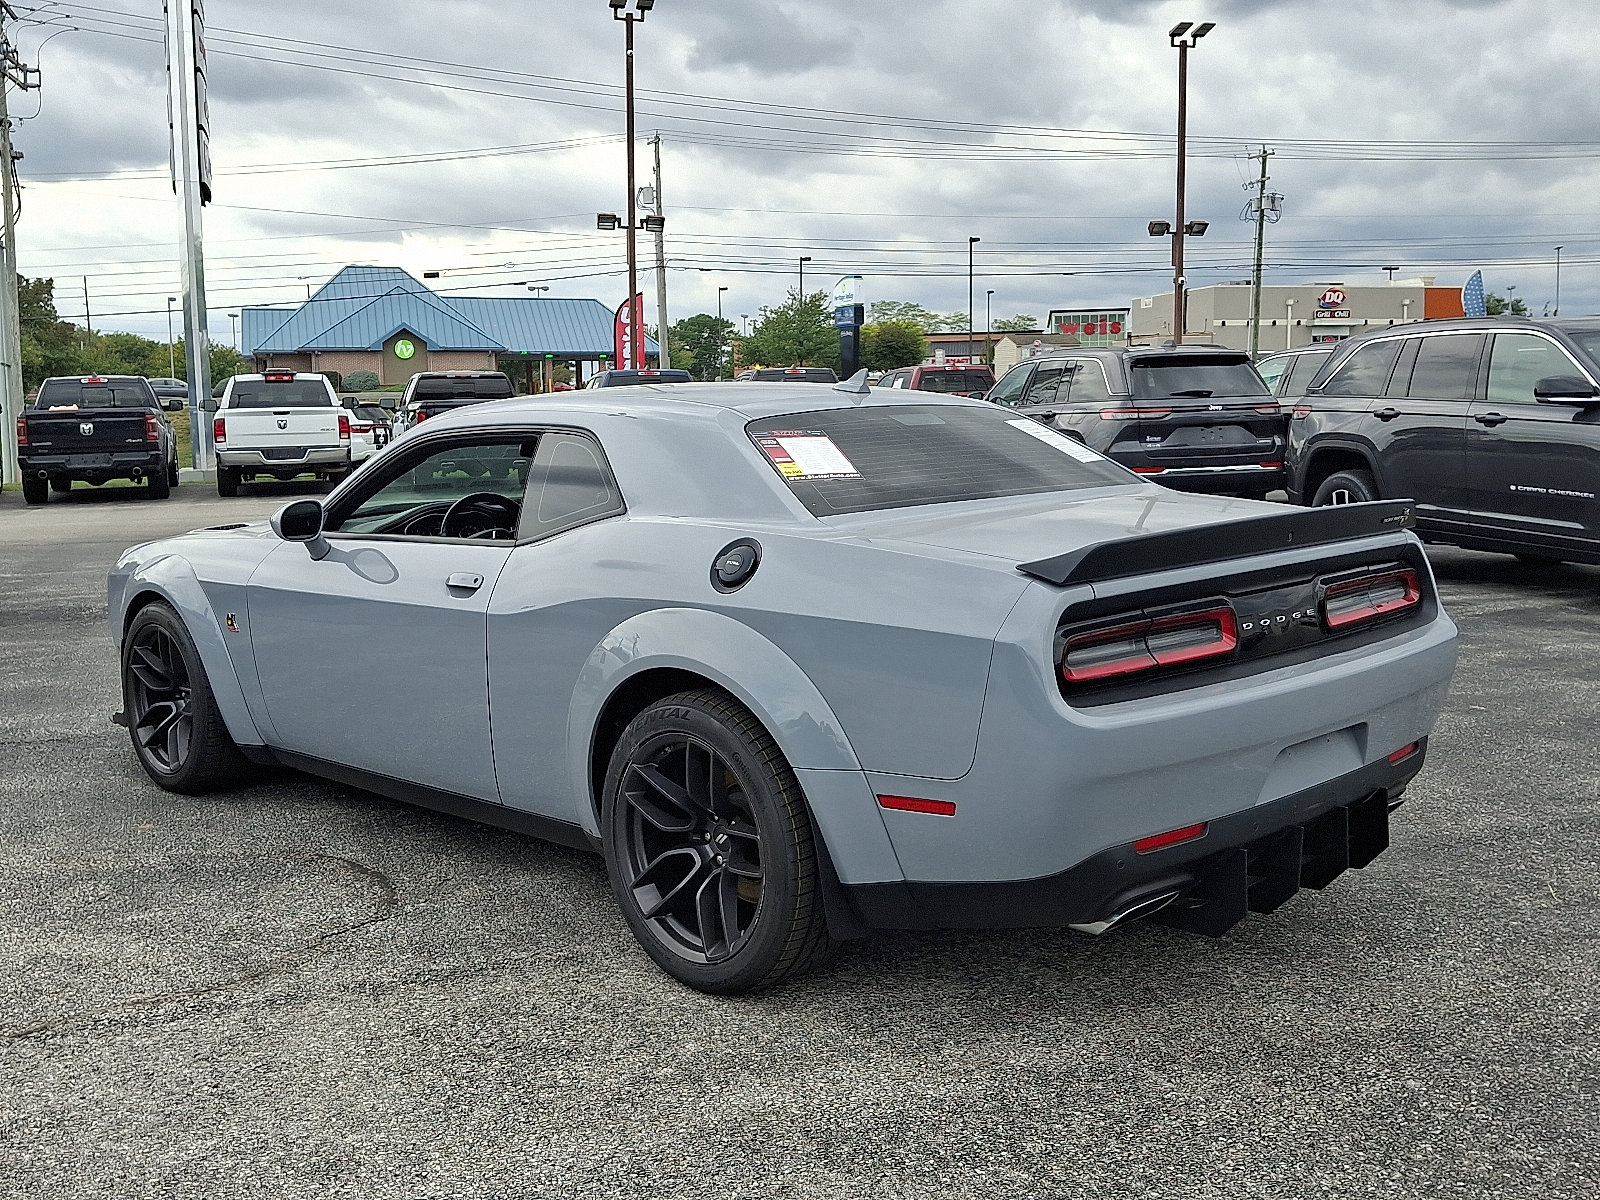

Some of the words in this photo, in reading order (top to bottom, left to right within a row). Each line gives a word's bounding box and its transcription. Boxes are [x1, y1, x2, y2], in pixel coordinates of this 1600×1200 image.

[1325, 291, 1344, 303] DQ
[1335, 310, 1349, 318] Chili
[1059, 317, 1122, 335] weis
[1517, 485, 1547, 494] GRAND
[1548, 488, 1595, 499] CHEROKEE
[1242, 608, 1315, 630] DODGE
